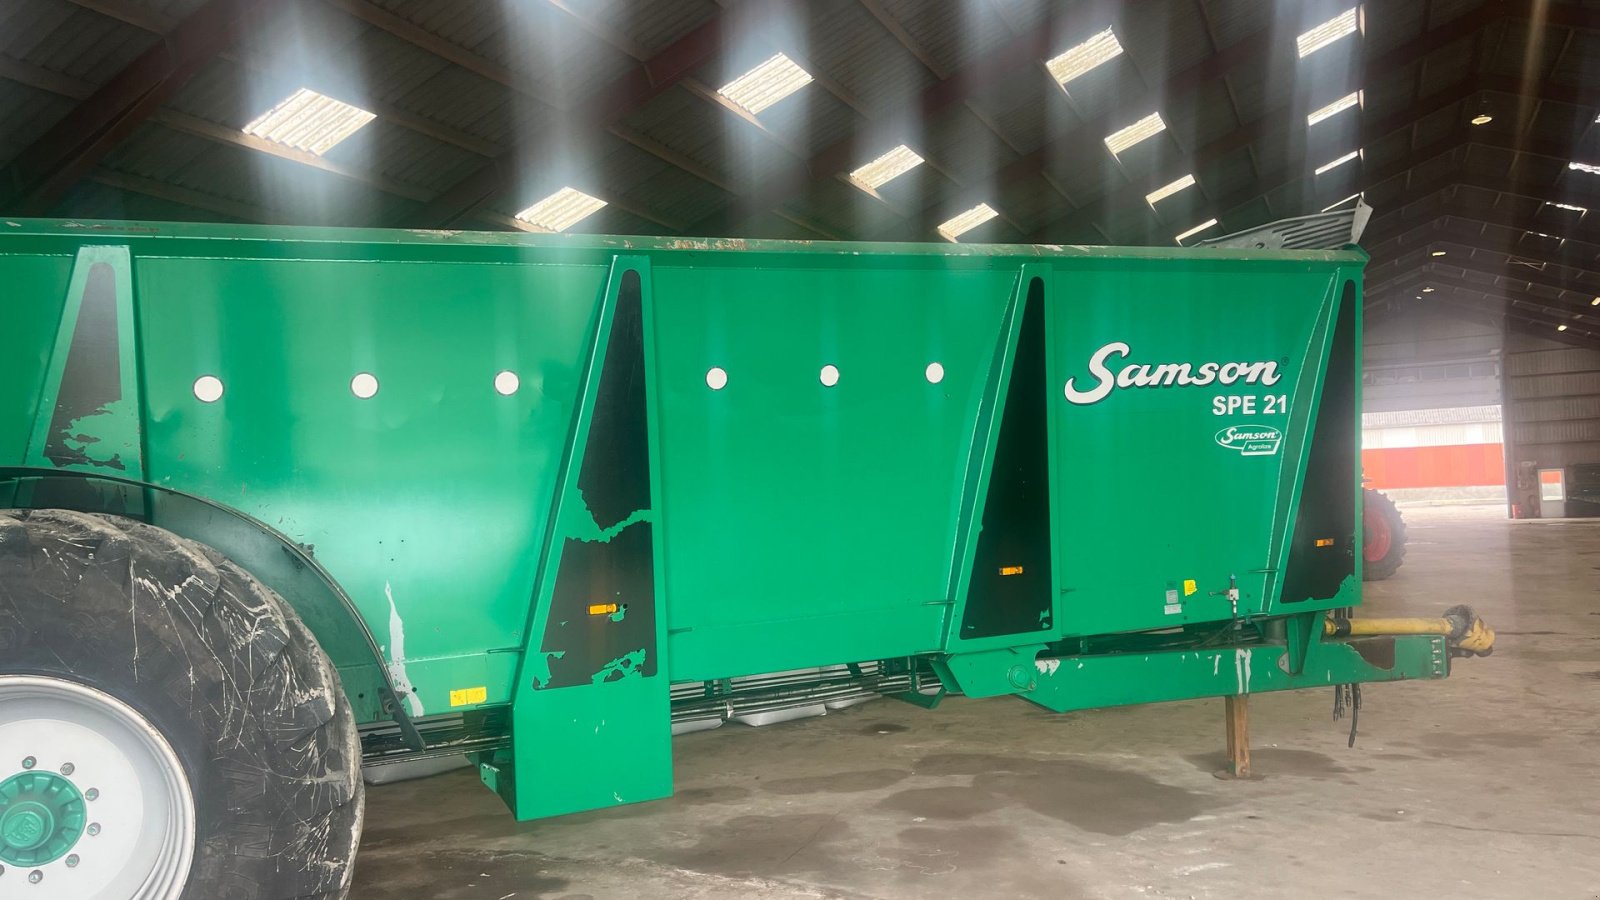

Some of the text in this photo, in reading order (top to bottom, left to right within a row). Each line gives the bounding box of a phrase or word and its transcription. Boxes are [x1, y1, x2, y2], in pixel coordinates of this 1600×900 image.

[1064, 341, 1282, 405] Samson
[1212, 394, 1287, 416] SPE 21
[1220, 427, 1277, 444] Samson
